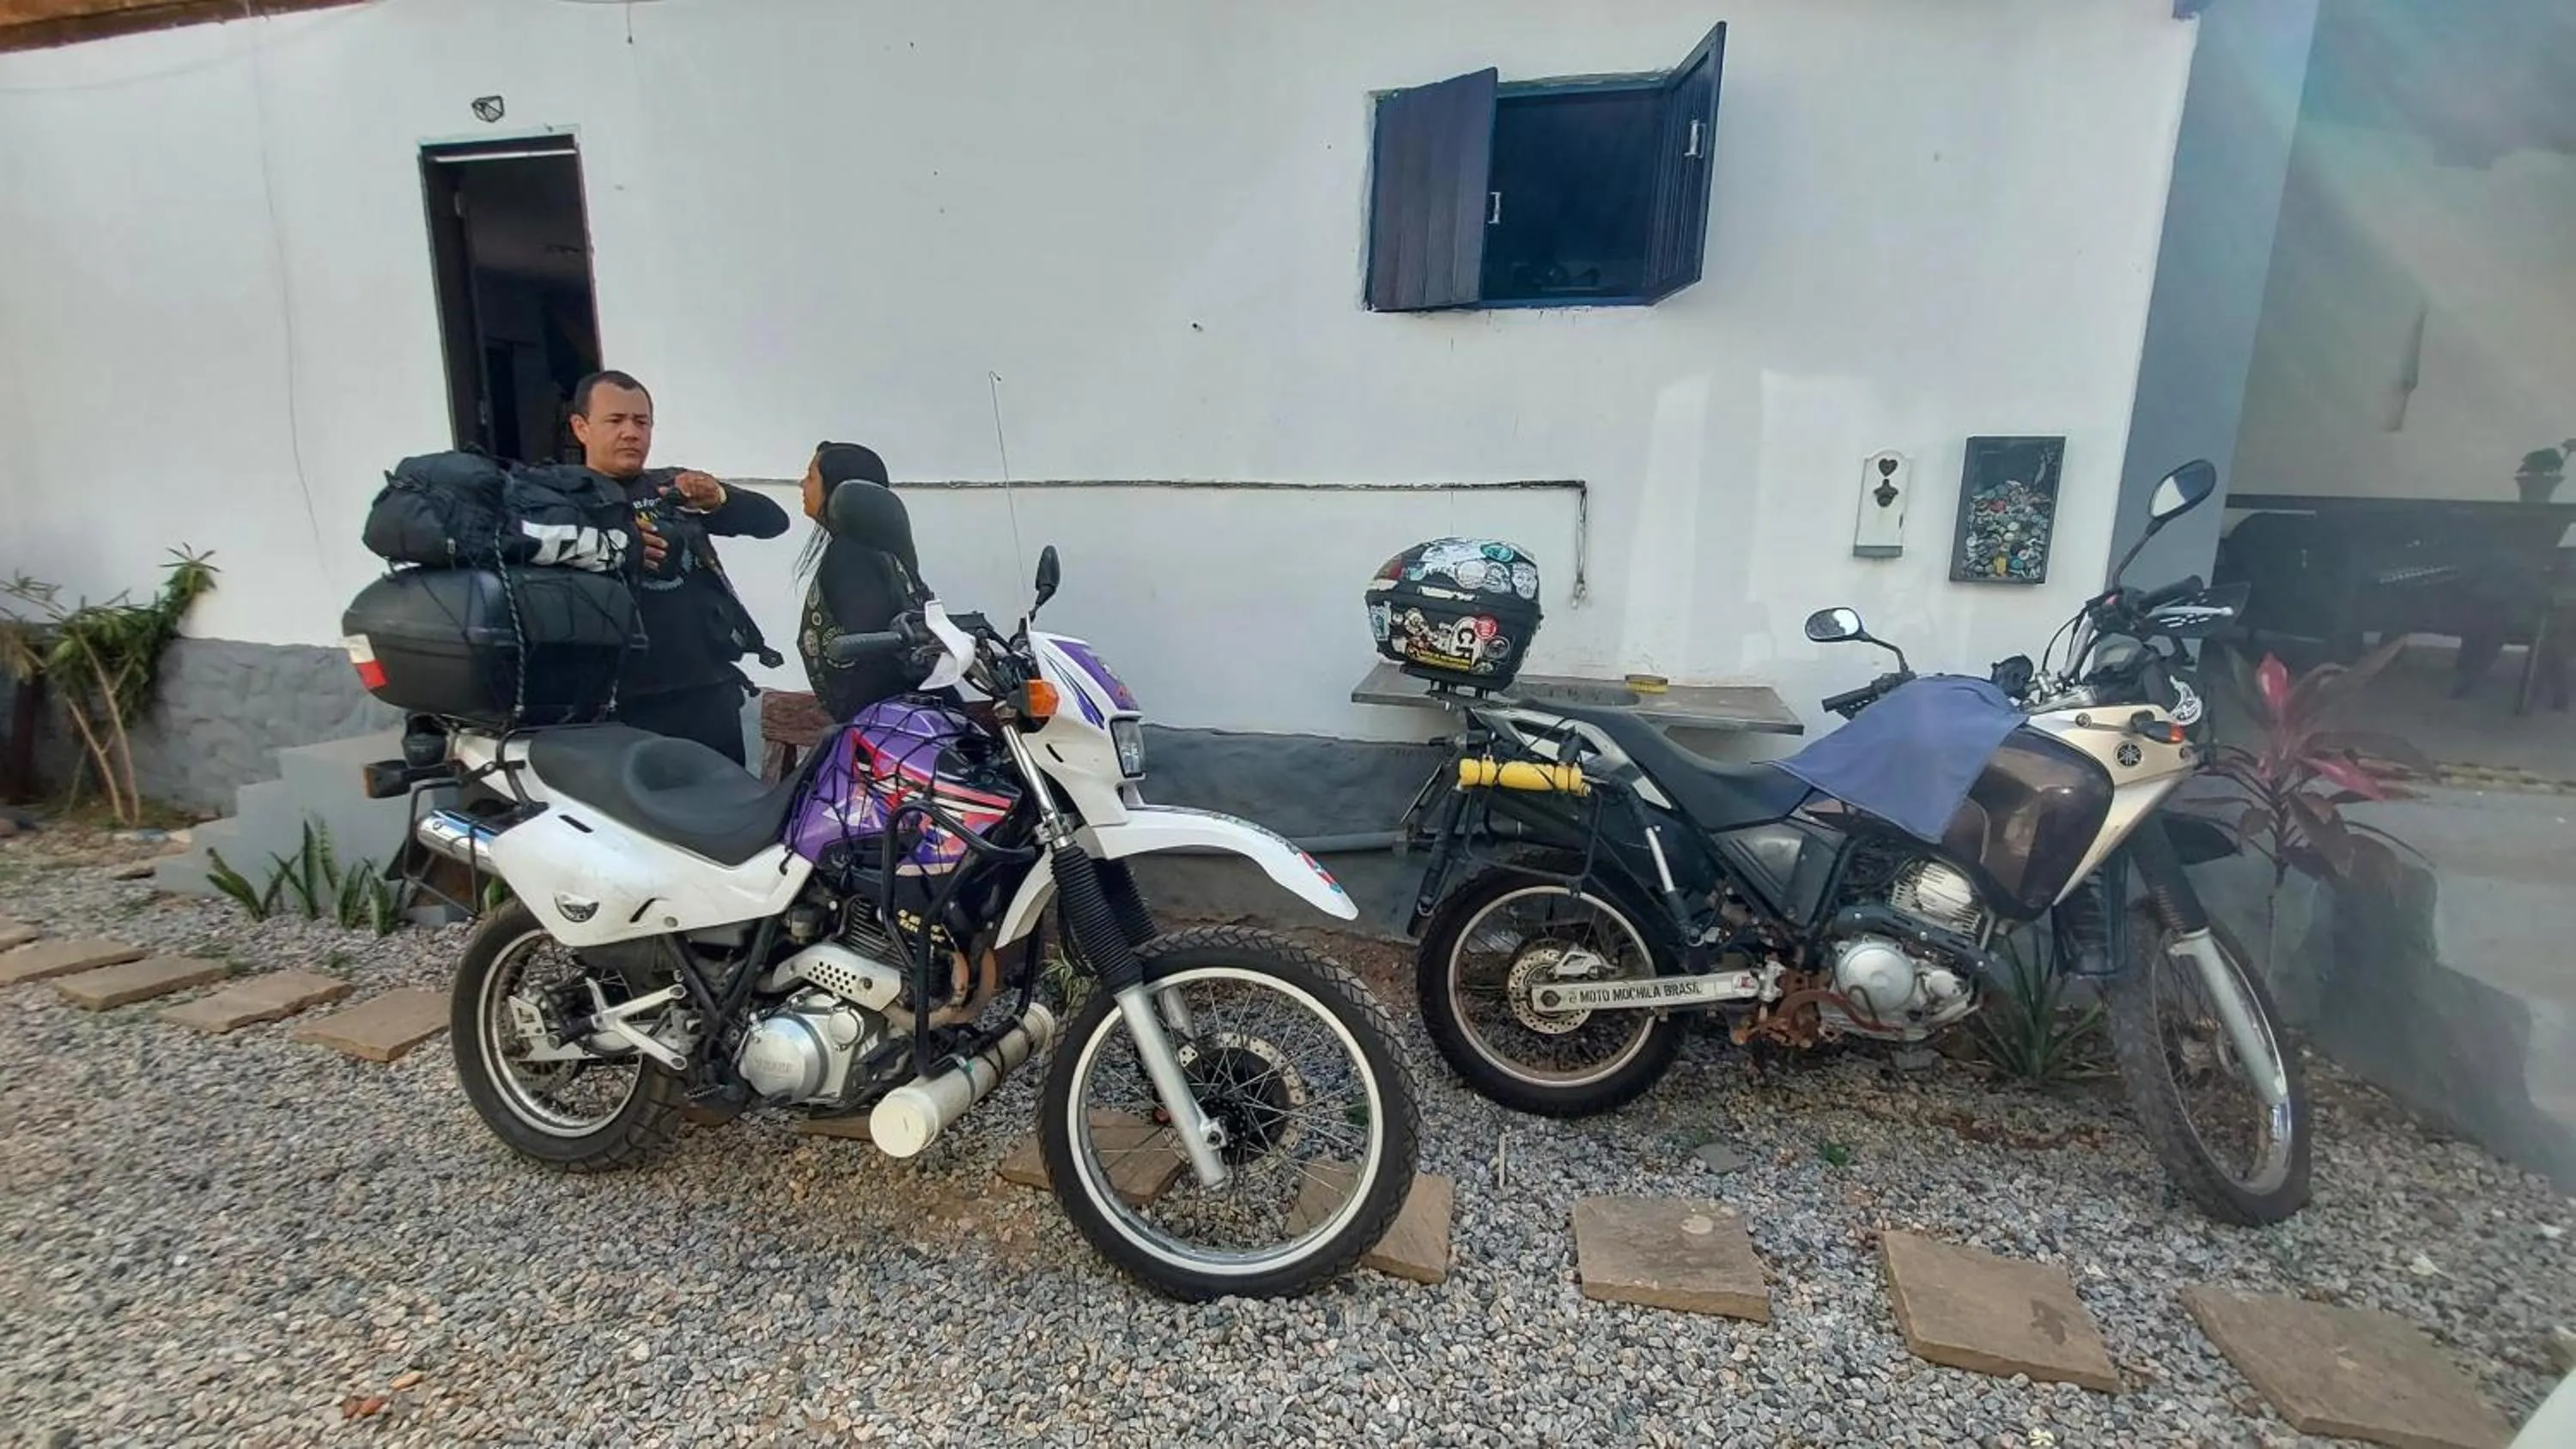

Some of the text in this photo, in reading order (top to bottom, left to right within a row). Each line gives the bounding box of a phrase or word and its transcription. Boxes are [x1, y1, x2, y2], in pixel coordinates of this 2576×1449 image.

[1580, 990, 1610, 1003] MOTO
[1613, 986, 1661, 1001] MOCHILA
[1663, 982, 1702, 997] BRASIL
